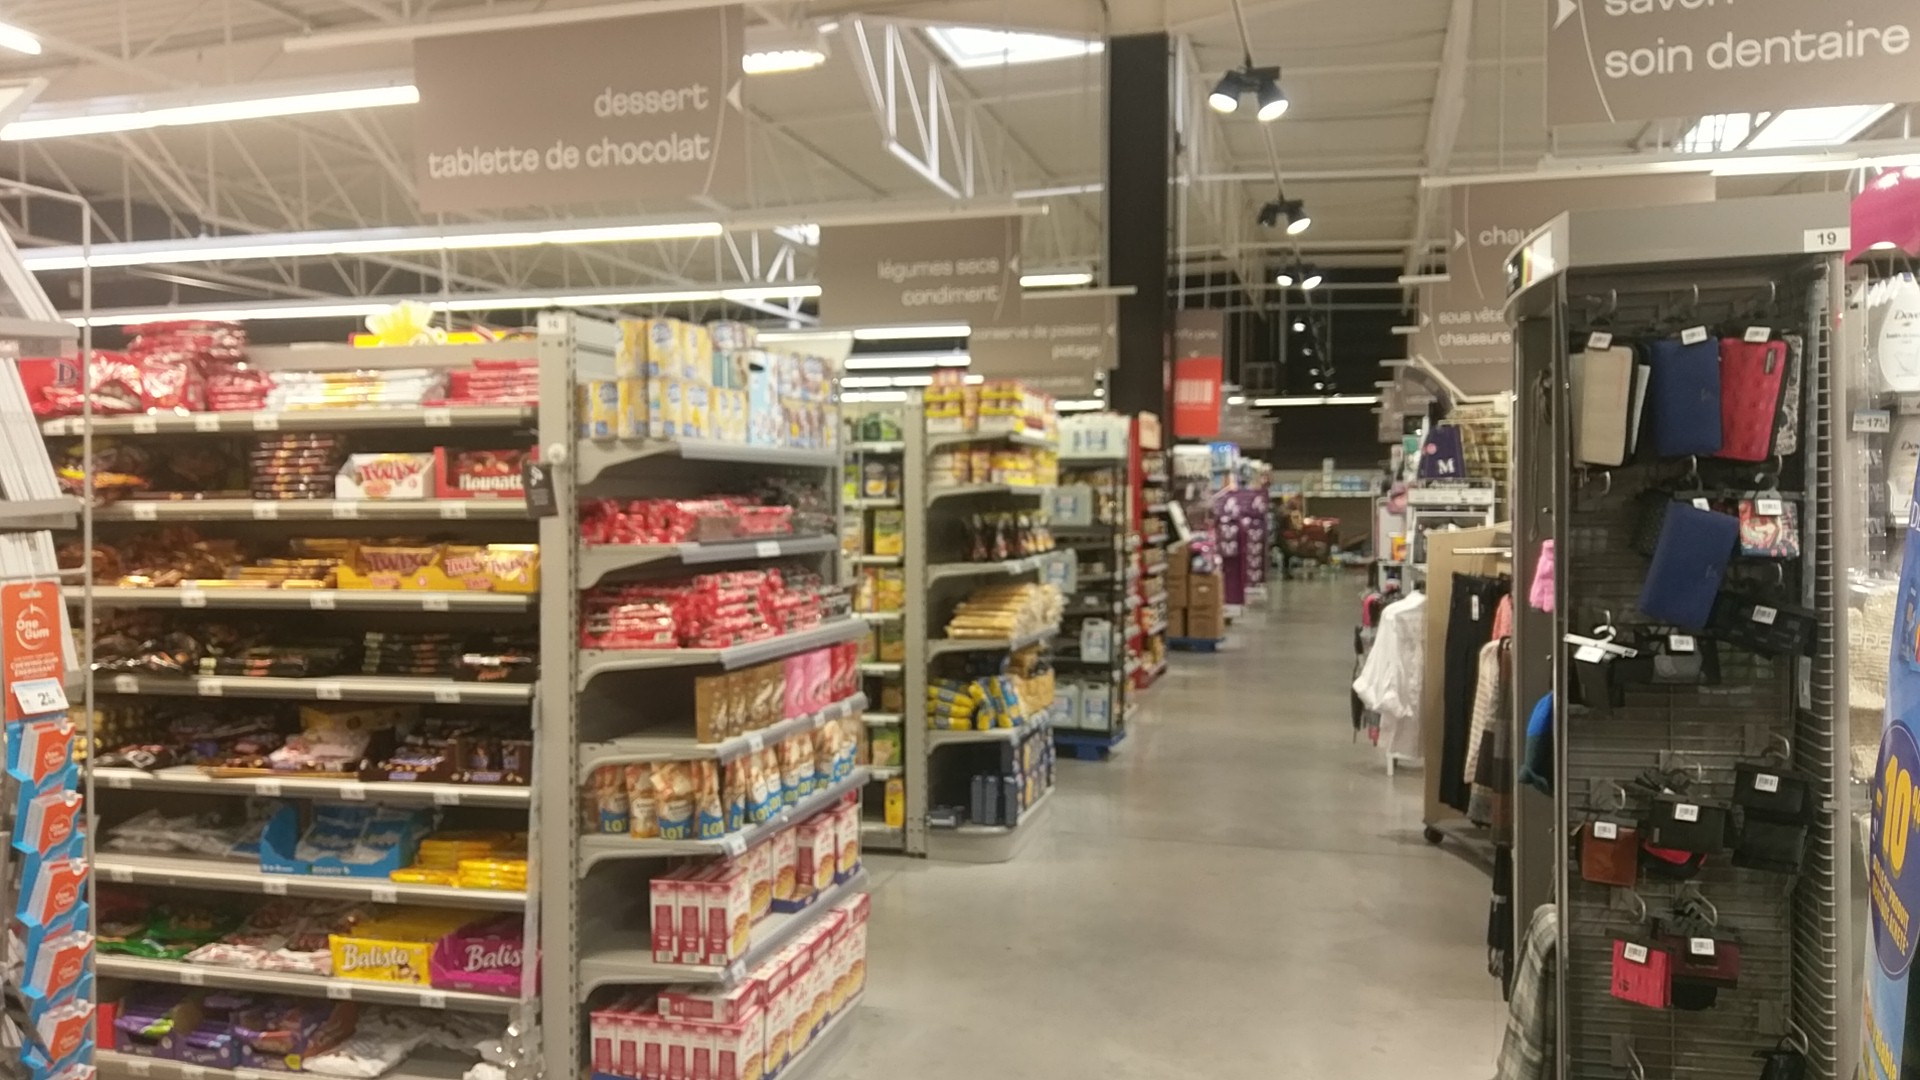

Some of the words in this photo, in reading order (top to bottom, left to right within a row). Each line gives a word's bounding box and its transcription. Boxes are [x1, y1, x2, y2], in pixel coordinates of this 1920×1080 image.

[1604, 37, 1693, 78] soin
[1706, 20, 1911, 70] dentaire
[594, 83, 709, 117] dessert
[428, 147, 539, 179] tablette
[545, 140, 580, 170] de
[585, 132, 710, 167] chocolat
[1817, 231, 1837, 246] 19
[877, 258, 953, 283] légumes
[955, 258, 999, 276] secs
[901, 284, 999, 306] condiment
[1437, 458, 1455, 474] M
[16, 619, 39, 631] One
[25, 628, 49, 640] Gum
[341, 944, 409, 972] Balisto
[464, 943, 524, 972] Balis
